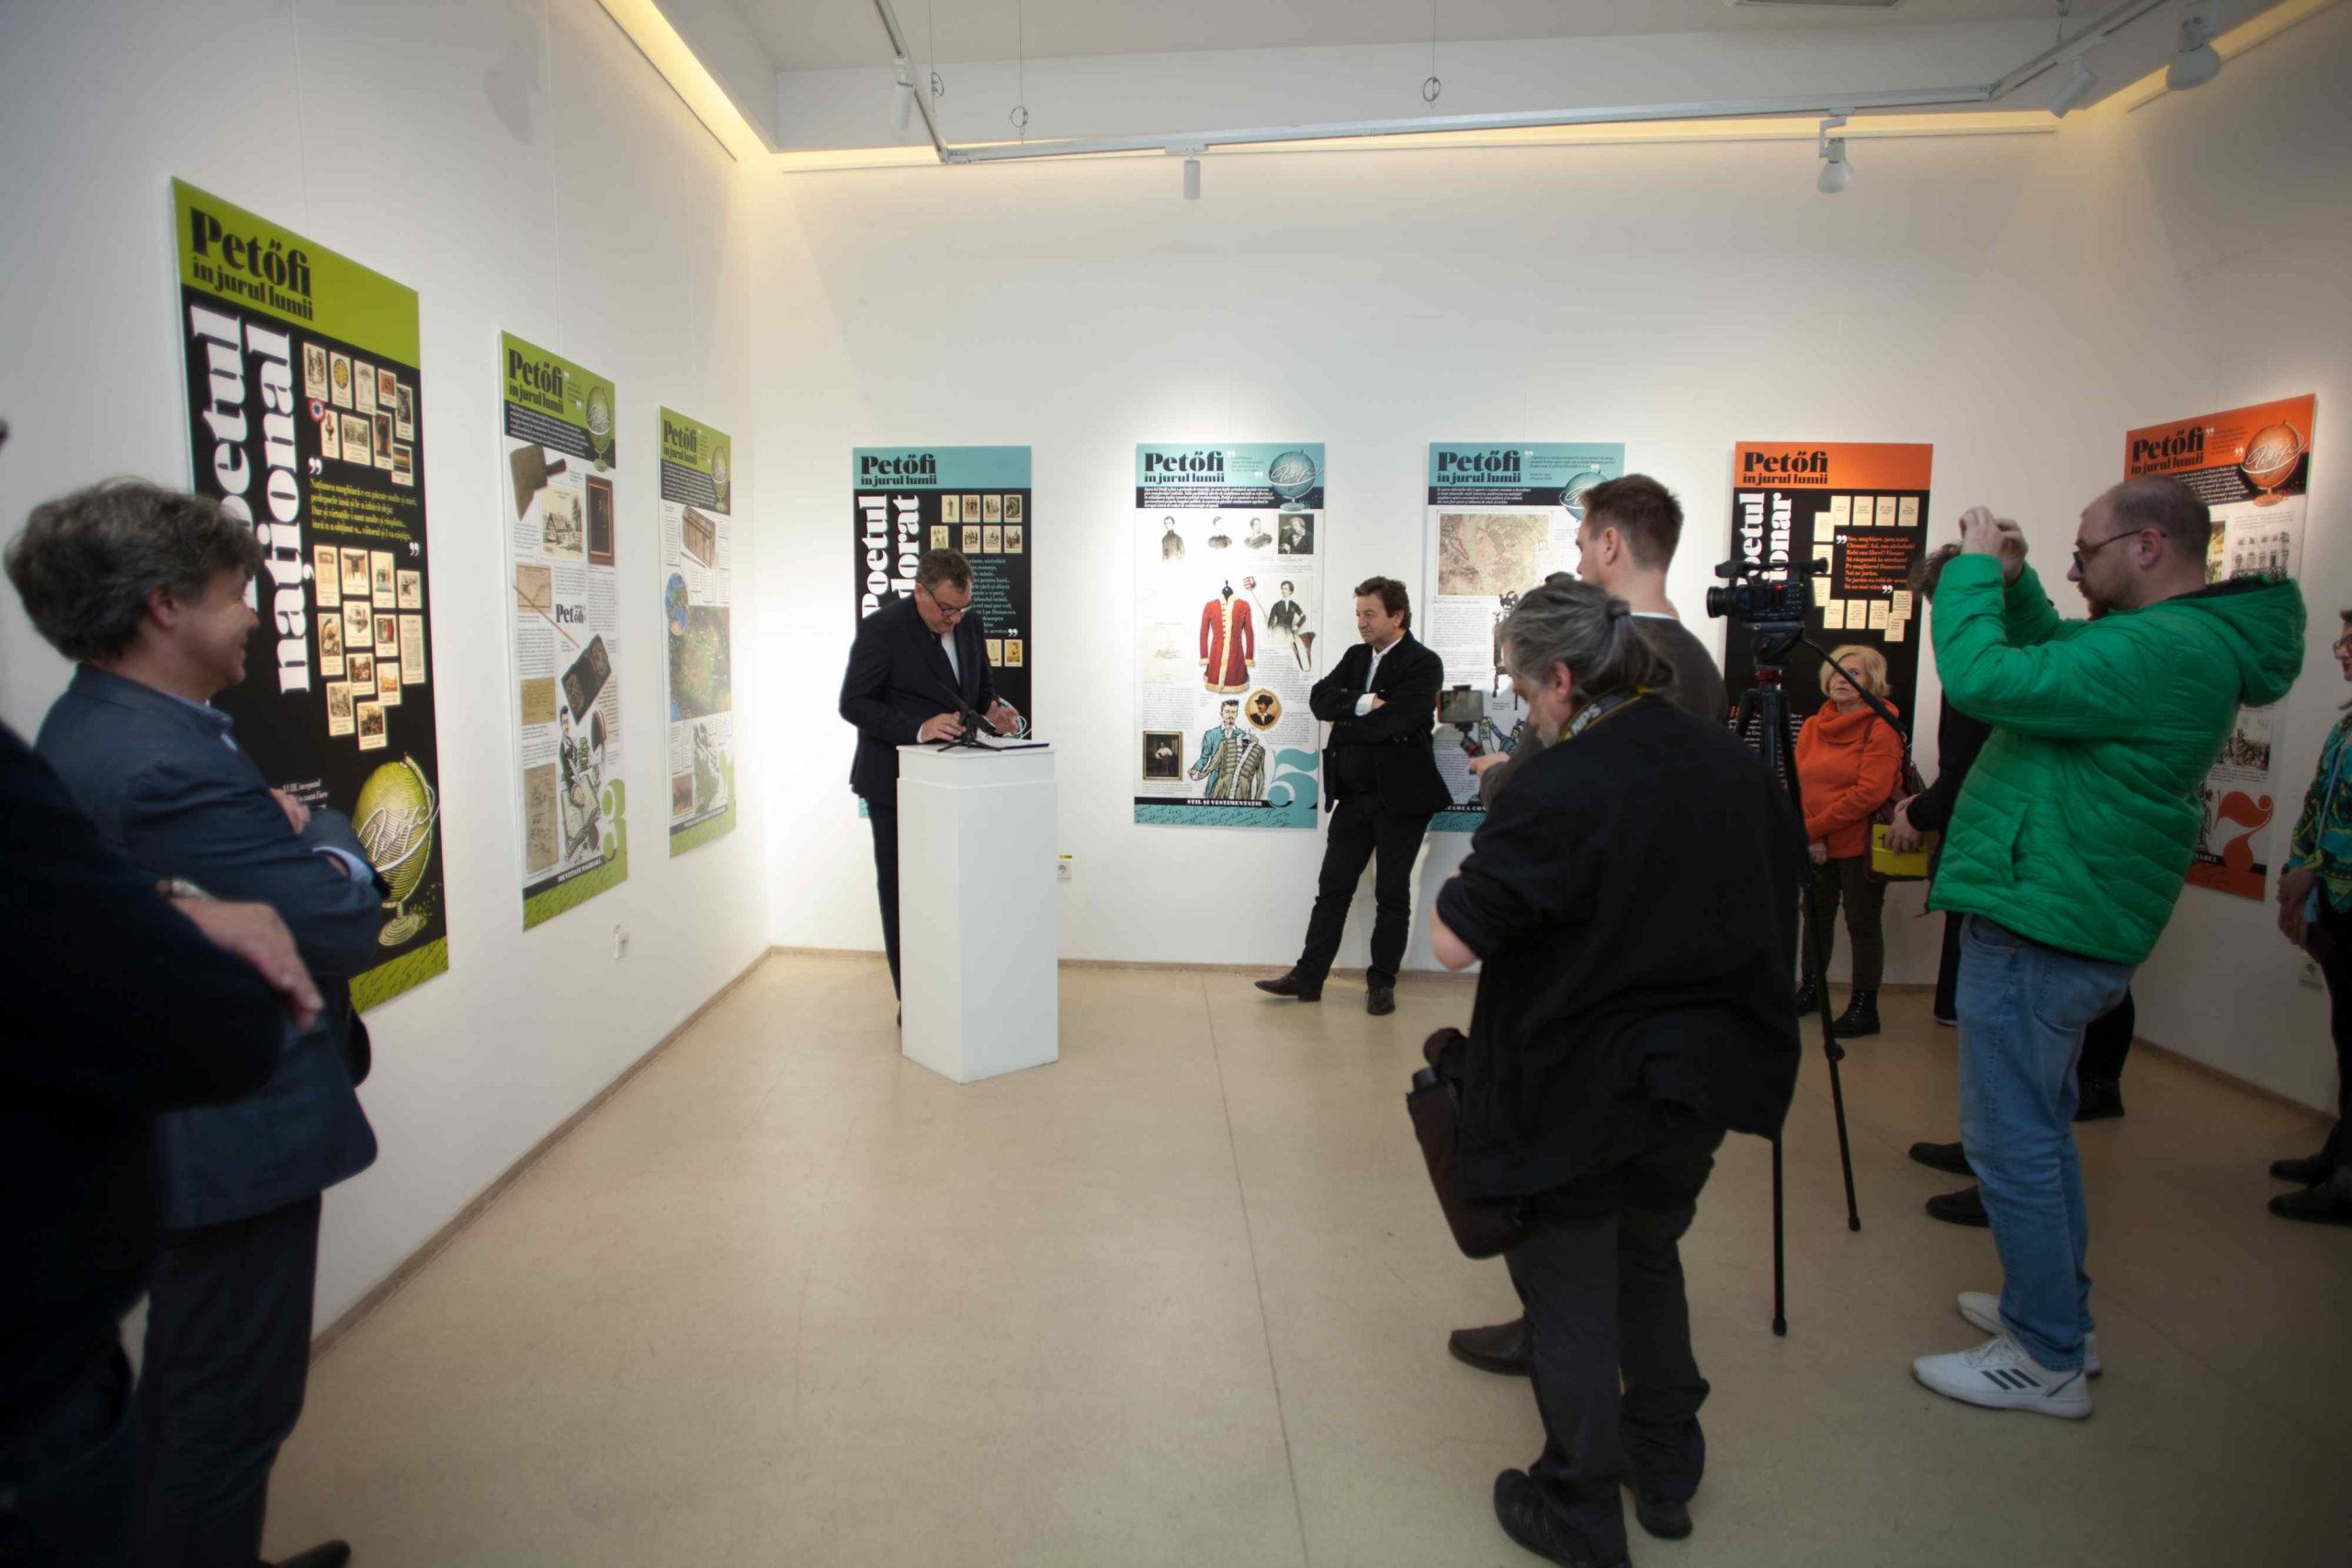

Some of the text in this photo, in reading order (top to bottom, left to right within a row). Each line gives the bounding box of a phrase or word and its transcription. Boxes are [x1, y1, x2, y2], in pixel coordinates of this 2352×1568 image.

[189, 206, 313, 299] Petőfi
[214, 264, 266, 304] jurul
[268, 285, 313, 321] lumii
[508, 348, 563, 399] Petőfi
[663, 419, 696, 454] Petőfi
[2132, 425, 2204, 462] Petőfi
[861, 453, 936, 475] Petőfi
[1145, 450, 1224, 472] Petőfi
[1438, 450, 1521, 472] Petőfi
[1743, 450, 1828, 473] Petőfi
[2143, 457, 2171, 475] jurul
[2173, 451, 2204, 469] lumii
[872, 475, 904, 487] jurul
[906, 475, 937, 485] lumii
[1157, 472, 1190, 485] jurul
[1193, 472, 1225, 483] lumii
[1450, 472, 1485, 485] jurul
[1487, 472, 1521, 483] lumii
[1756, 473, 1792, 486] jurul
[1793, 474, 1828, 485] lumii
[1570, 703, 1601, 736] NPS
[1267, 748, 1319, 809] 5
[602, 778, 628, 862] 3
[2214, 790, 2274, 872] 7
